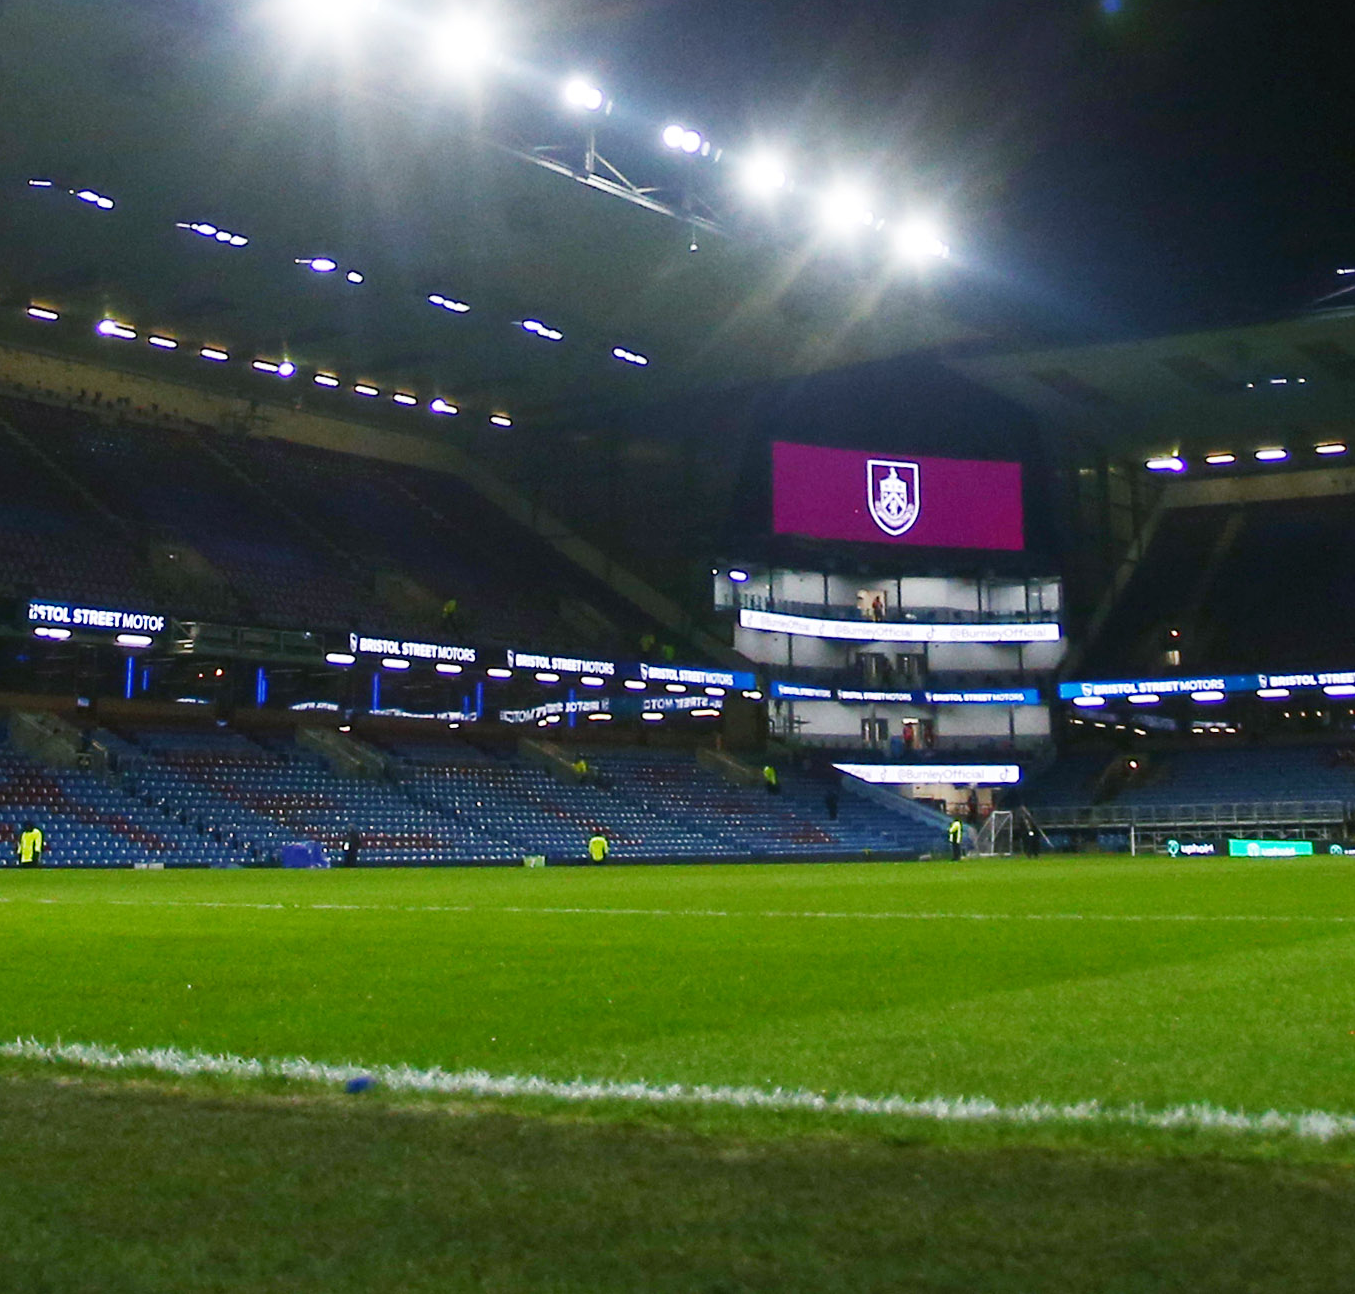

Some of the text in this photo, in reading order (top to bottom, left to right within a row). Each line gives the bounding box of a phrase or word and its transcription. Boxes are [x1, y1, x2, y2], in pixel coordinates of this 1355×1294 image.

[72, 608, 122, 628] STREET
[359, 637, 476, 663] BRISTOL STREET MOTORS
[515, 653, 615, 676] BRISTOL STREET MOTORS
[1093, 678, 1225, 696] BRISTOL STREET MOTORS
[1269, 674, 1317, 688] BRISTOL
[898, 768, 985, 783] @BurnleyOfficial
